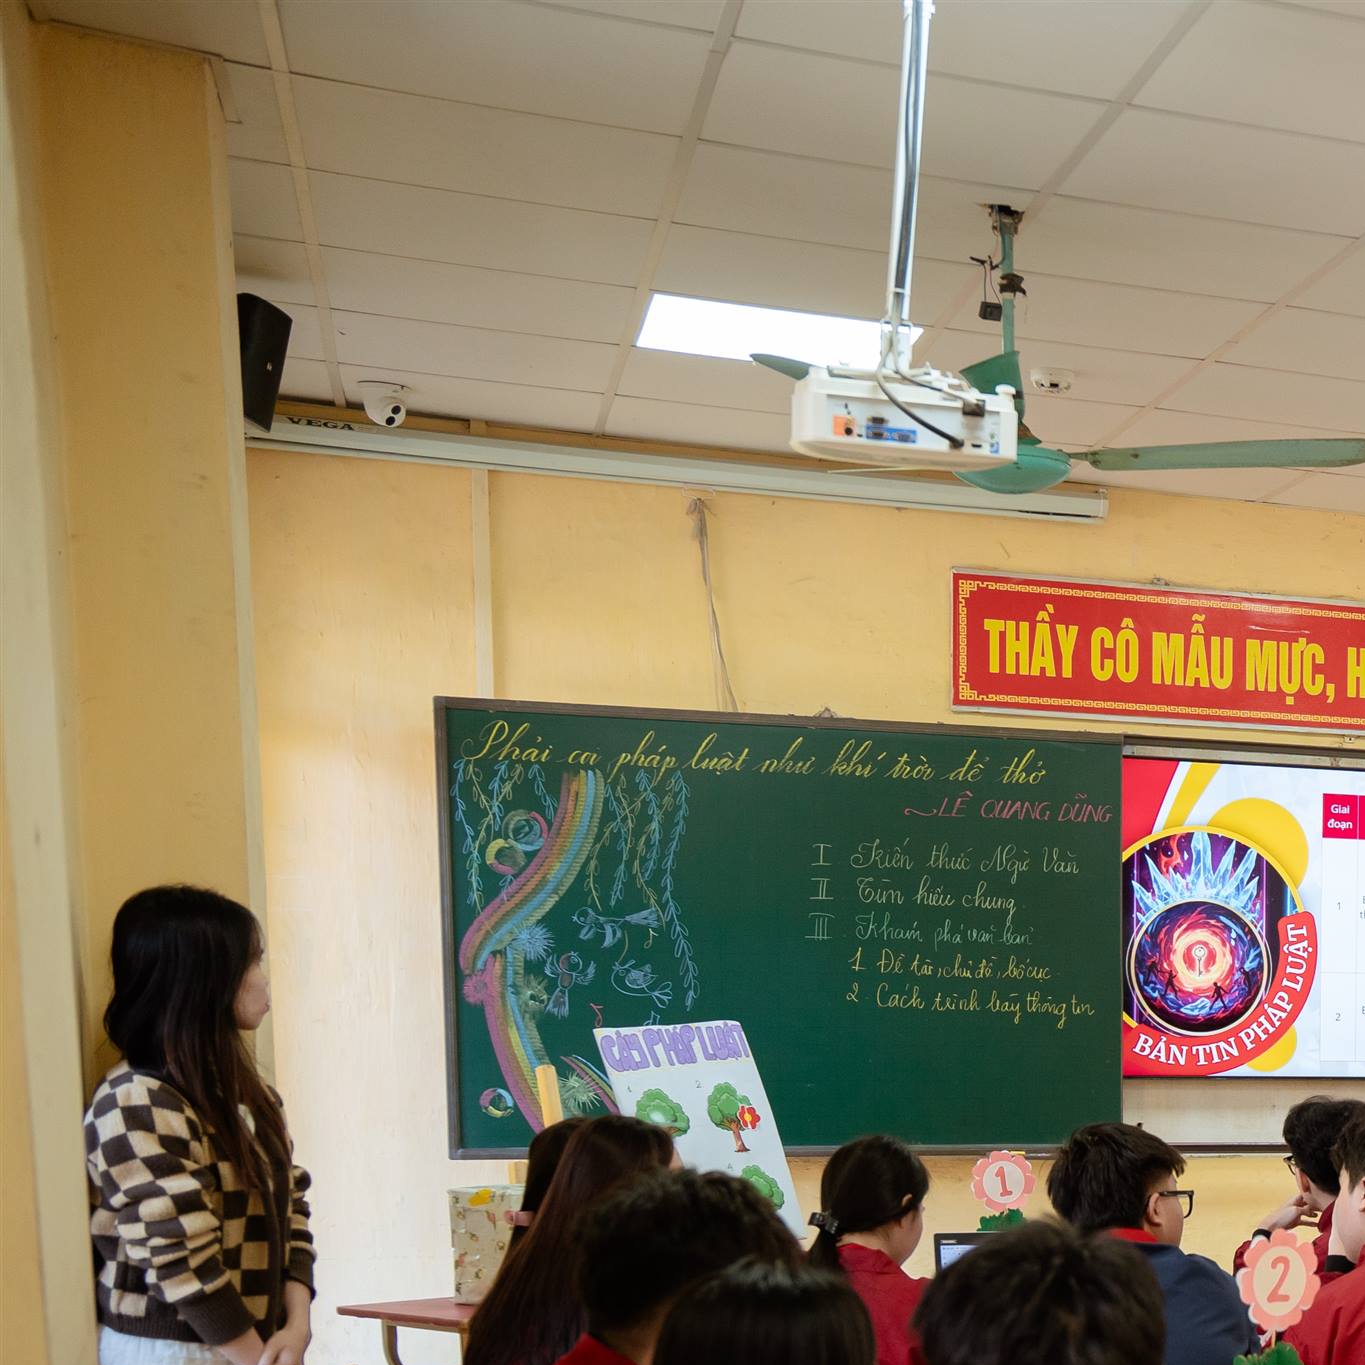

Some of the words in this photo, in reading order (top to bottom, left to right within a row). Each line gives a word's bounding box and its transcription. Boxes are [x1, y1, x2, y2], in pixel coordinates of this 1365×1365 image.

[286, 416, 354, 430] VEGA
[984, 603, 1079, 679] THẦY
[1090, 618, 1139, 684] CÔ
[1152, 613, 1234, 690] MẪU
[1245, 637, 1335, 705] MỰC,
[461, 720, 553, 762] Phải
[608, 730, 678, 786] pháp
[682, 731, 749, 775] luật
[761, 736, 815, 775] như
[821, 739, 887, 777] khí
[940, 749, 991, 782] để
[998, 748, 1048, 785] thở
[980, 799, 1051, 821] QUANG
[1058, 793, 1113, 823] DŨNG
[1331, 804, 1350, 814] Giai
[1327, 819, 1352, 830] đoạn
[926, 842, 972, 870] thức
[1042, 847, 1079, 874] Văn
[857, 877, 904, 905] Tìm
[877, 983, 925, 1009] Cách
[1132, 1033, 1188, 1065] BẢN
[1192, 1038, 1239, 1065] TIN
[1239, 990, 1293, 1051] PHÁP
[1282, 922, 1313, 992] LUẬT
[1335, 1013, 1341, 1021] 2
[642, 1024, 697, 1067] PHÁP
[696, 1022, 751, 1061] LUẬT
[995, 1167, 1012, 1197] 1
[1267, 1256, 1290, 1303] 2
